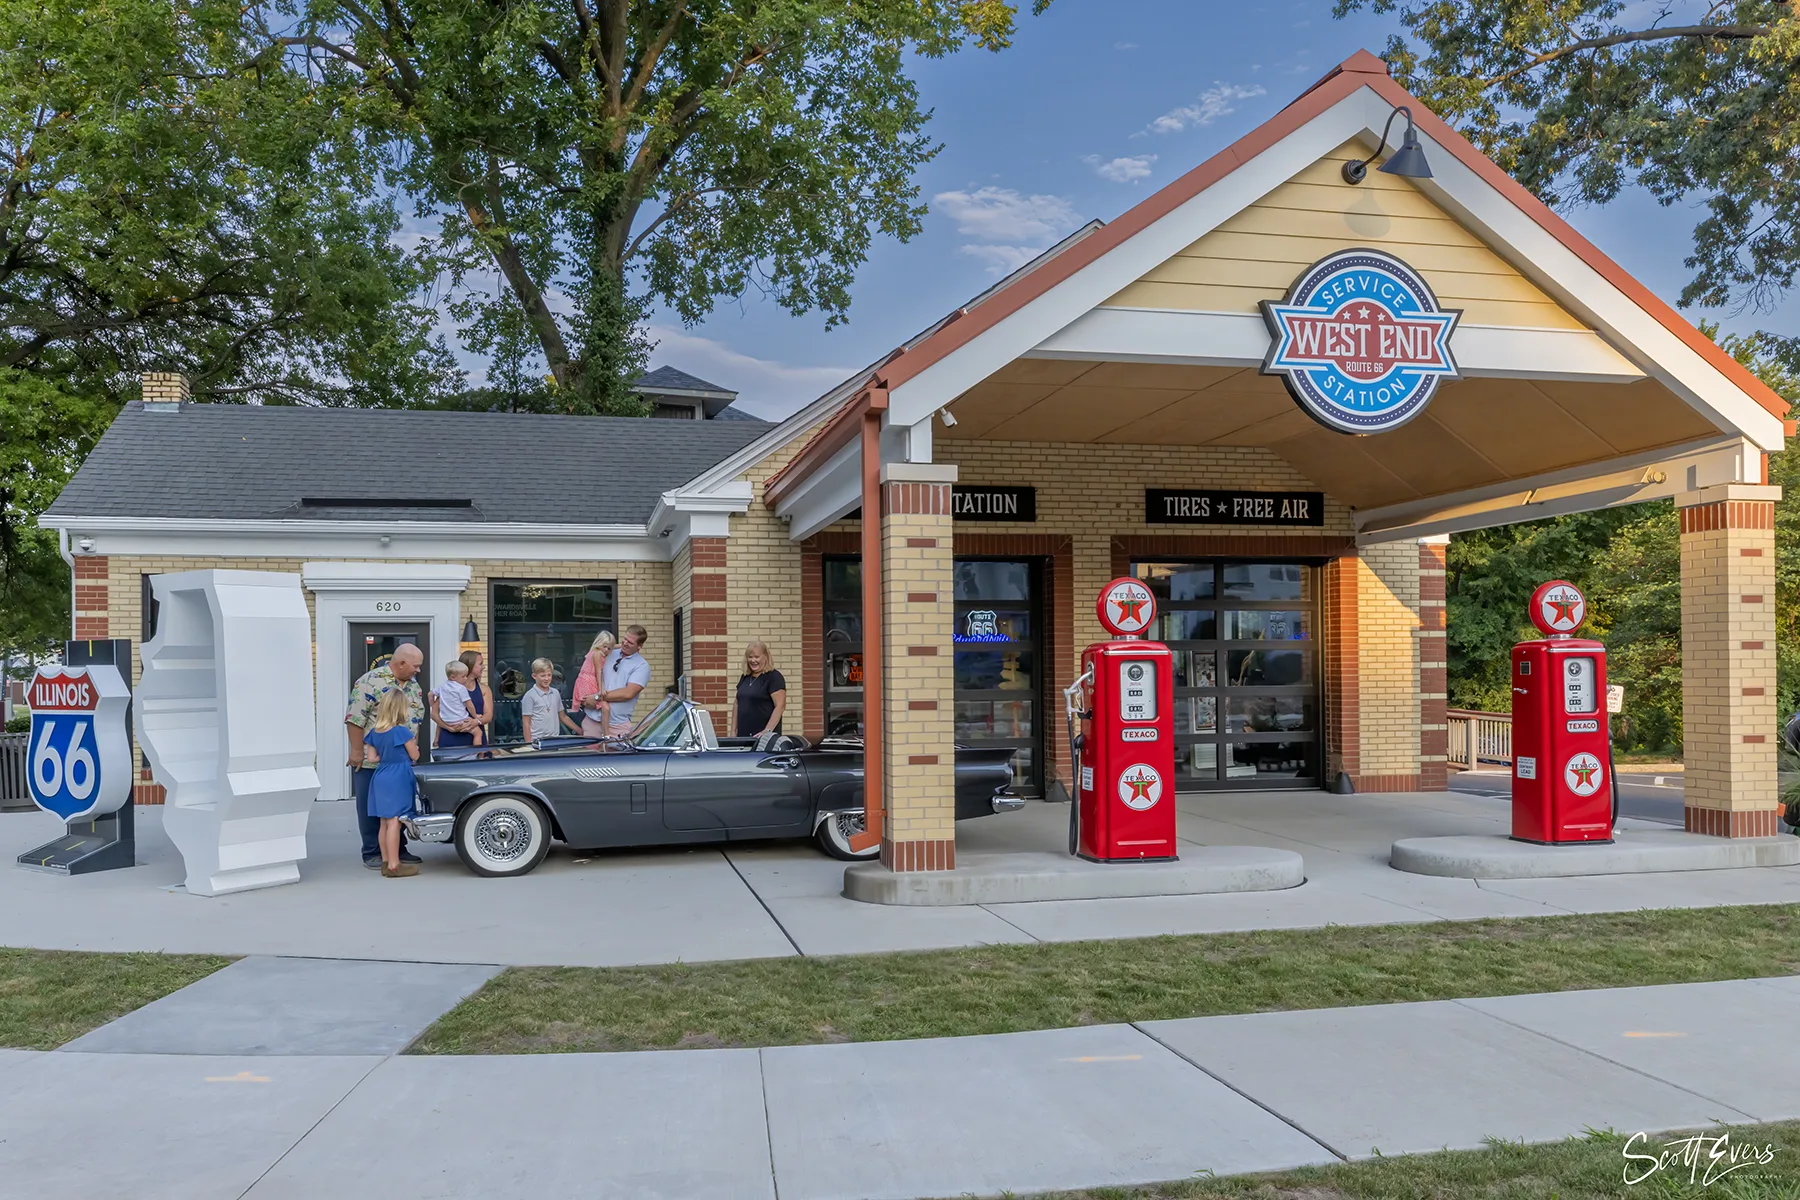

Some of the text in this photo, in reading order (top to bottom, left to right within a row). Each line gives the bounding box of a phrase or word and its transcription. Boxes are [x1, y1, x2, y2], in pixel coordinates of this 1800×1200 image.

[1321, 275, 1406, 308] SERVICE
[1292, 320, 1432, 360] WEST END
[1345, 361, 1384, 373] ROUTE 66
[1323, 375, 1406, 406] STATION
[1163, 496, 1310, 519] TIRES FREE AIR
[376, 601, 401, 611] 620
[1113, 592, 1147, 600] TEXACO
[971, 621, 993, 636] 66
[36, 683, 90, 707] ILLINOIS
[1568, 722, 1596, 730] TEXACO
[33, 720, 96, 800] 66
